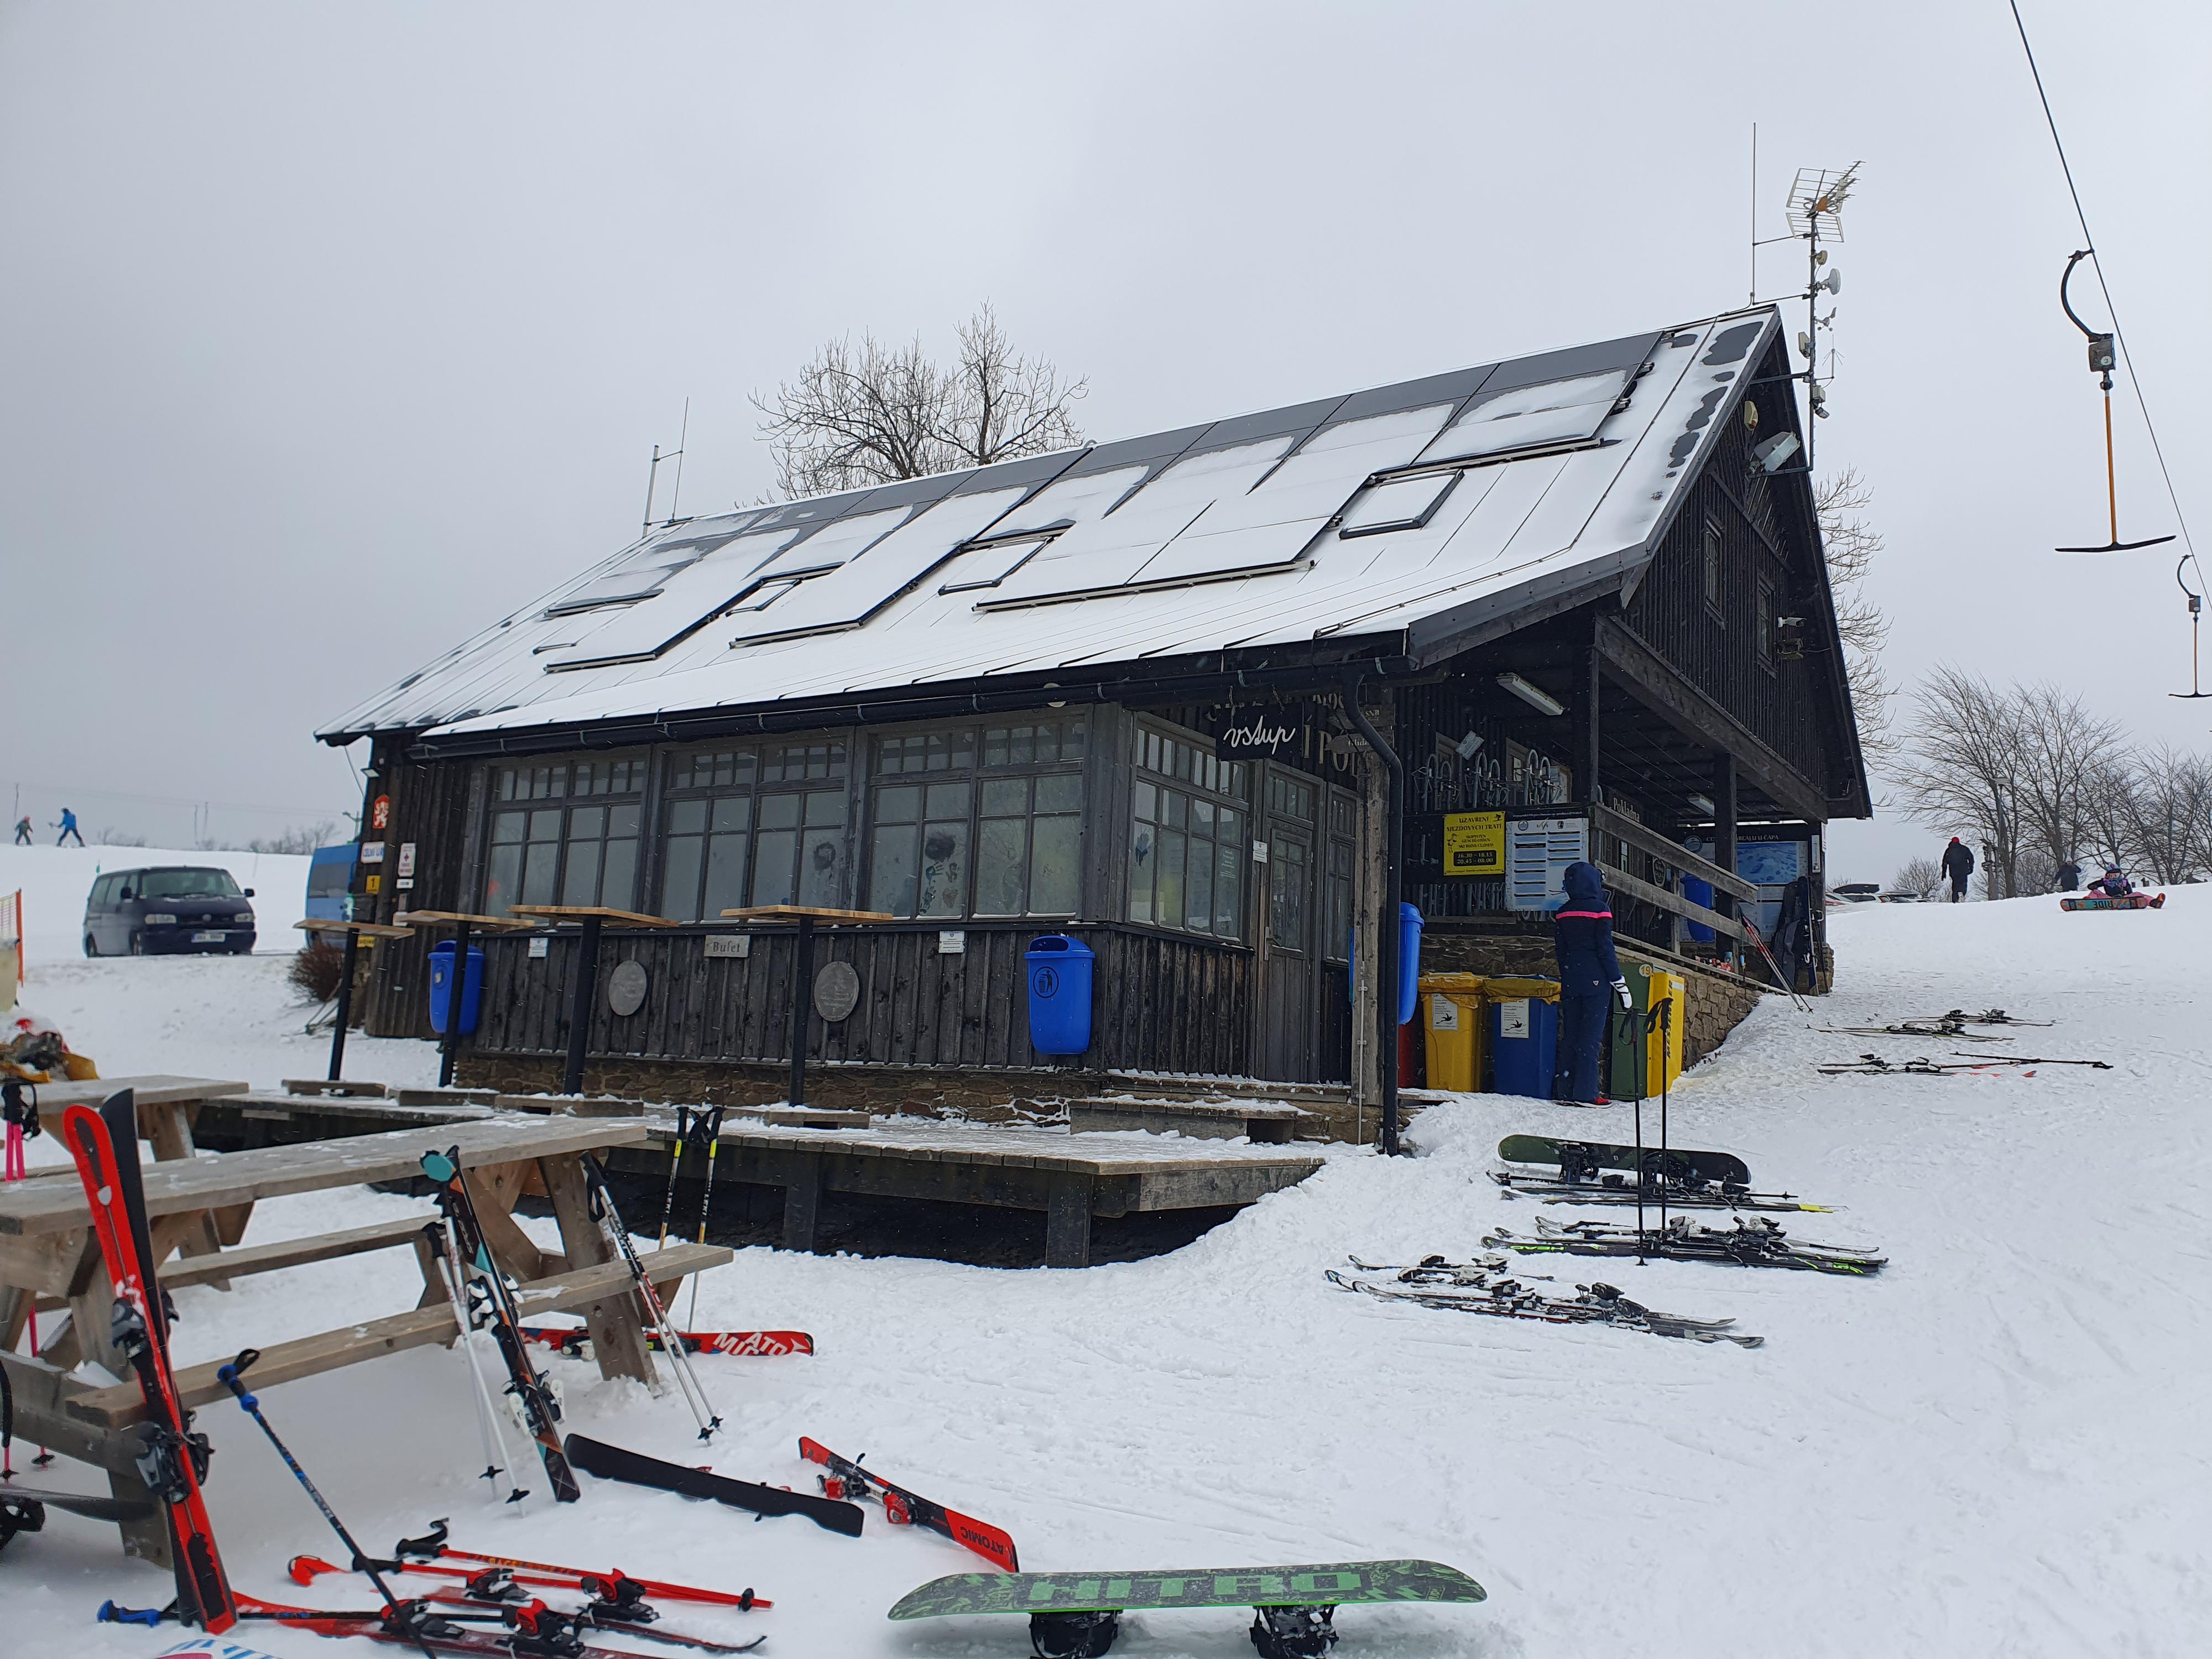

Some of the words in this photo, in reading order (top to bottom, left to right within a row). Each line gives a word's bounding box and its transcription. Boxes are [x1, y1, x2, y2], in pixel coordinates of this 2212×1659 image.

[1223, 715, 1296, 755] vstup
[2093, 900, 2114, 909] RIDE
[713, 941, 740, 952] Bufet
[1641, 966, 1651, 975] 19
[960, 1526, 1004, 1554] ATOMIC
